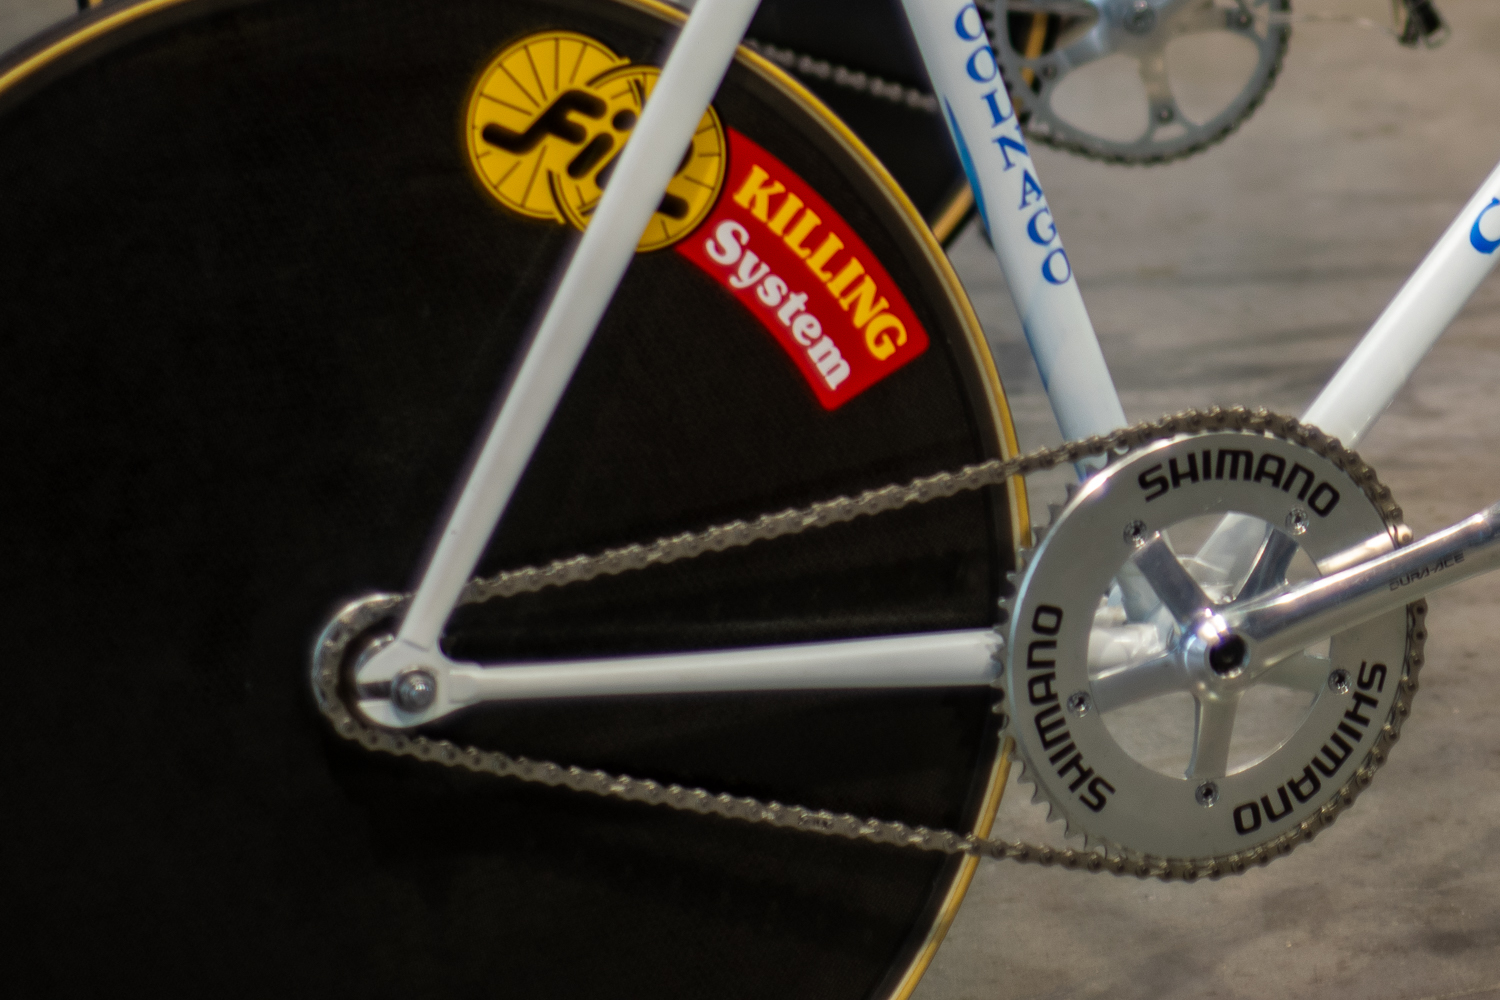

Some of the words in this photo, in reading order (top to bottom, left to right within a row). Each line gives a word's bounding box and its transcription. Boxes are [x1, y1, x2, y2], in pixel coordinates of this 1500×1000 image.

[954, 2, 1074, 287] COLNAGO
[704, 218, 851, 392] System
[732, 163, 908, 362] KILLING
[1138, 448, 1341, 519] SHIMANO
[1026, 603, 1117, 814] SHIMANO
[1231, 660, 1388, 837] SHIMANO
